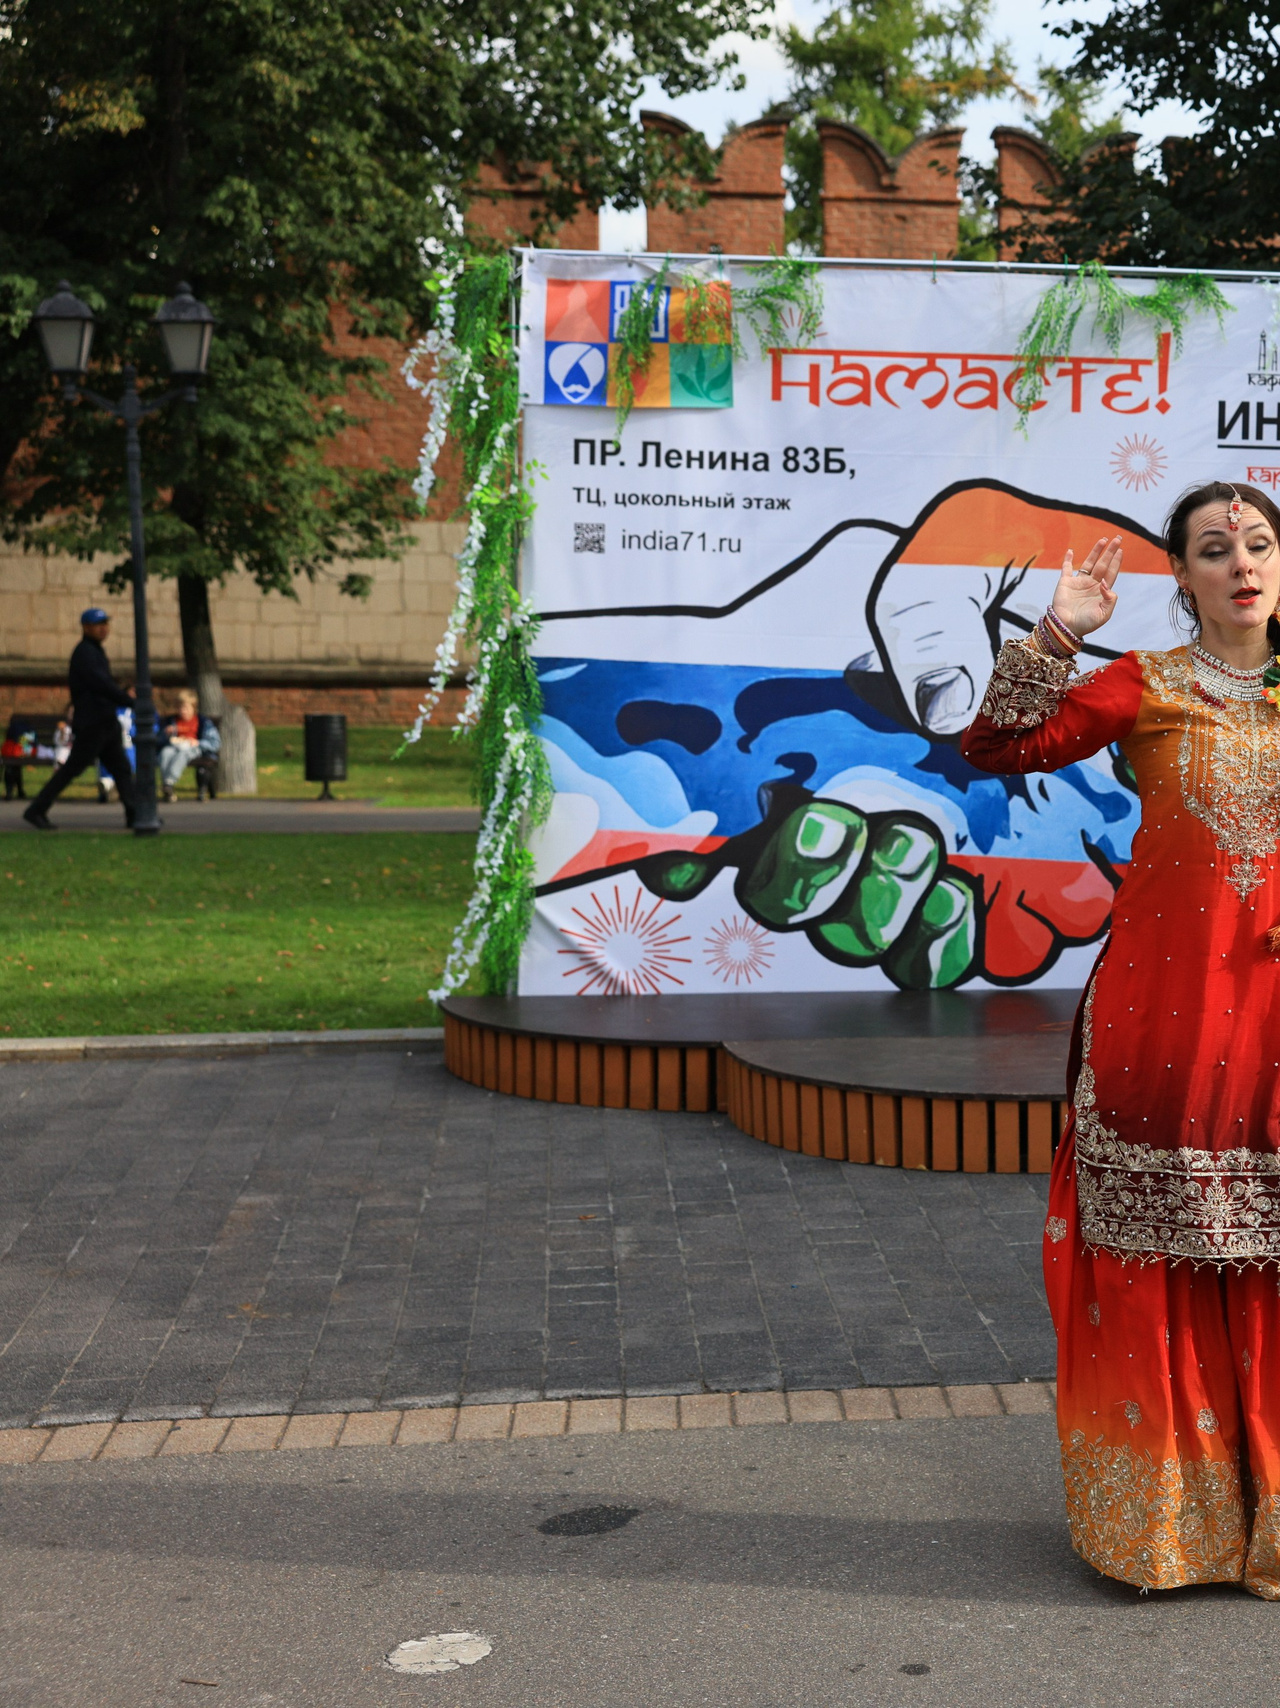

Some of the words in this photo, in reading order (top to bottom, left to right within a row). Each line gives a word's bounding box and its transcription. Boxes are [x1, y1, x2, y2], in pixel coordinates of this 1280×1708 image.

[573, 438, 626, 468] ПР.
[638, 441, 770, 472] Ленина
[782, 446, 856, 480] 83Б,
[573, 487, 607, 508] ТЦ,
[615, 492, 736, 509] цокольный
[743, 498, 791, 511] этаж
[621, 530, 742, 553] india71.ru
